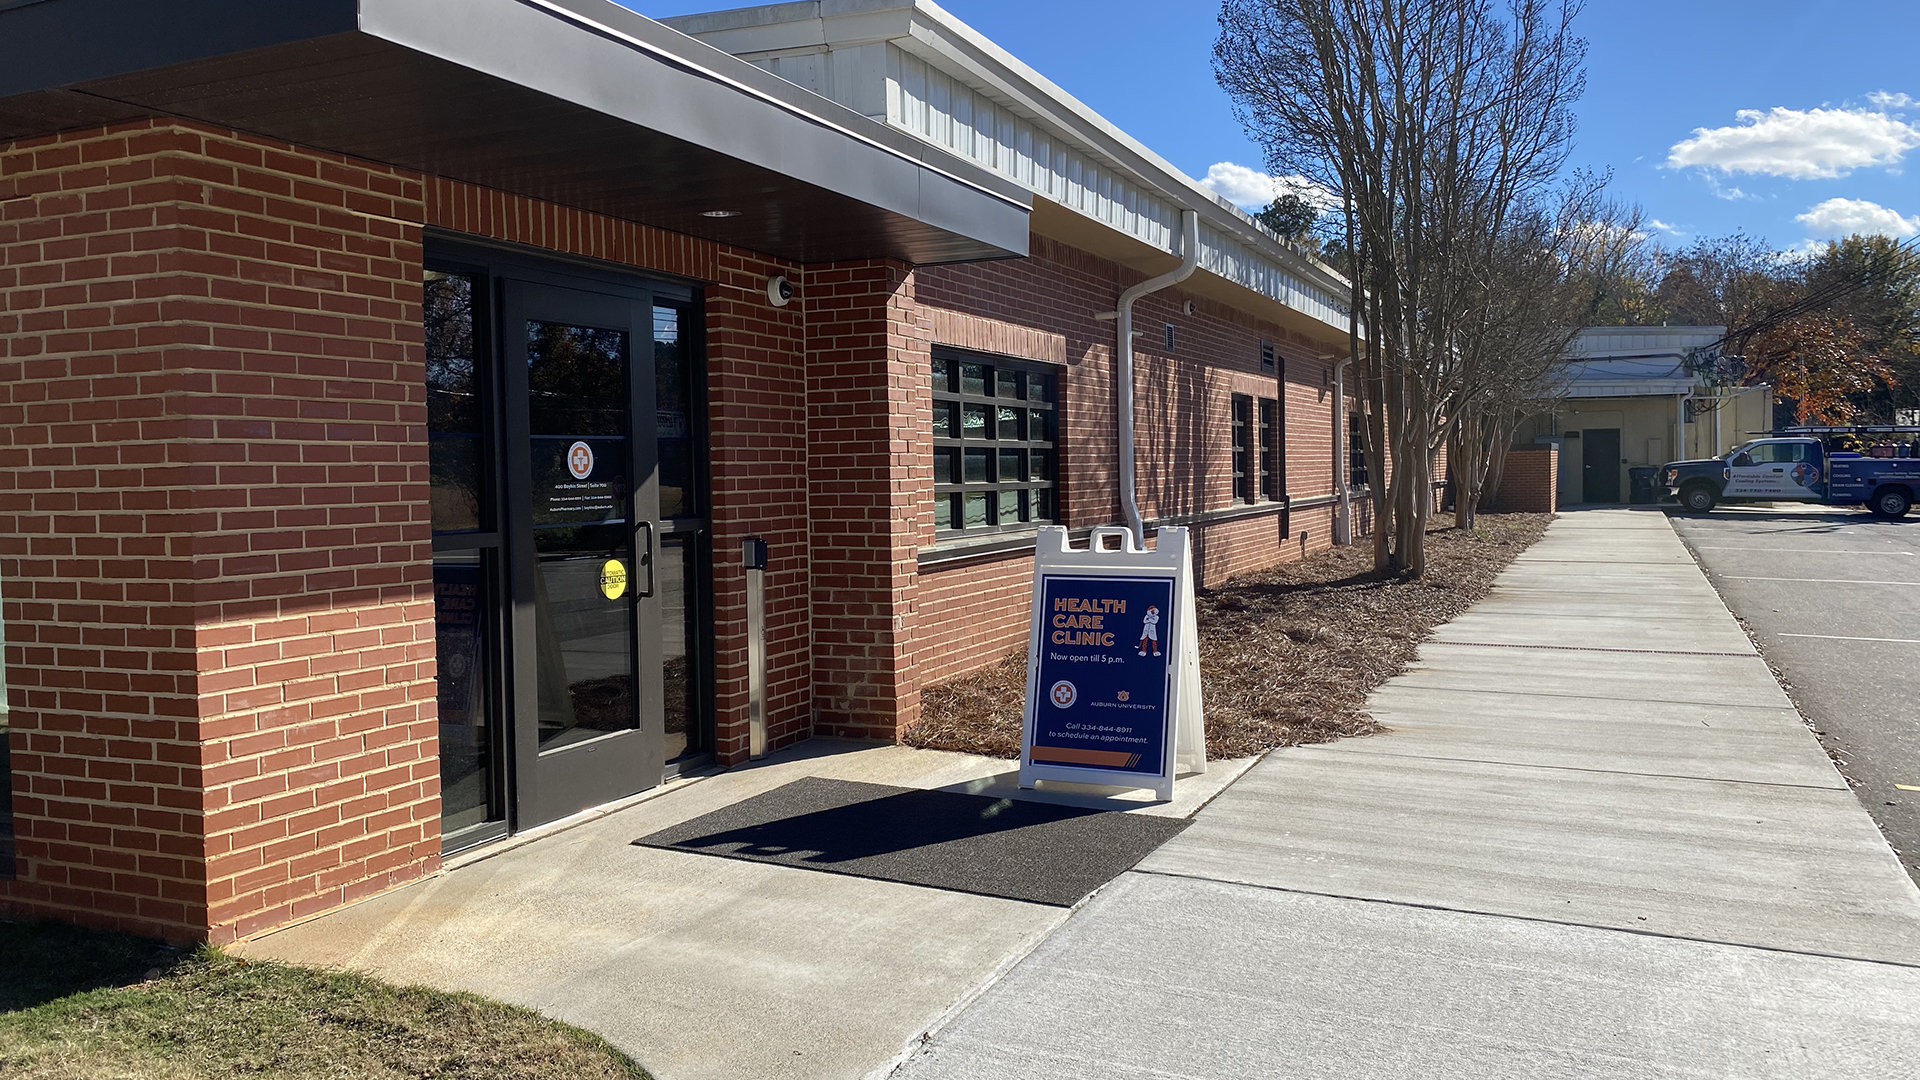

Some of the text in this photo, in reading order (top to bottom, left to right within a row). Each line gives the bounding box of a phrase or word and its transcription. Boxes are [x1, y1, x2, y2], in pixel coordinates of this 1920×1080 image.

[600, 576, 626, 585] CAUTION
[1054, 598, 1127, 613] HEALTH
[1052, 614, 1104, 630] CARE
[1051, 630, 1115, 647] CLINIC
[1050, 652, 1125, 665] Now open till 5 p.m.
[1065, 722, 1133, 733] Call 334-844-8911
[1048, 730, 1057, 738] to
[1057, 731, 1090, 740] schedule
[1100, 735, 1149, 744] appointment.
